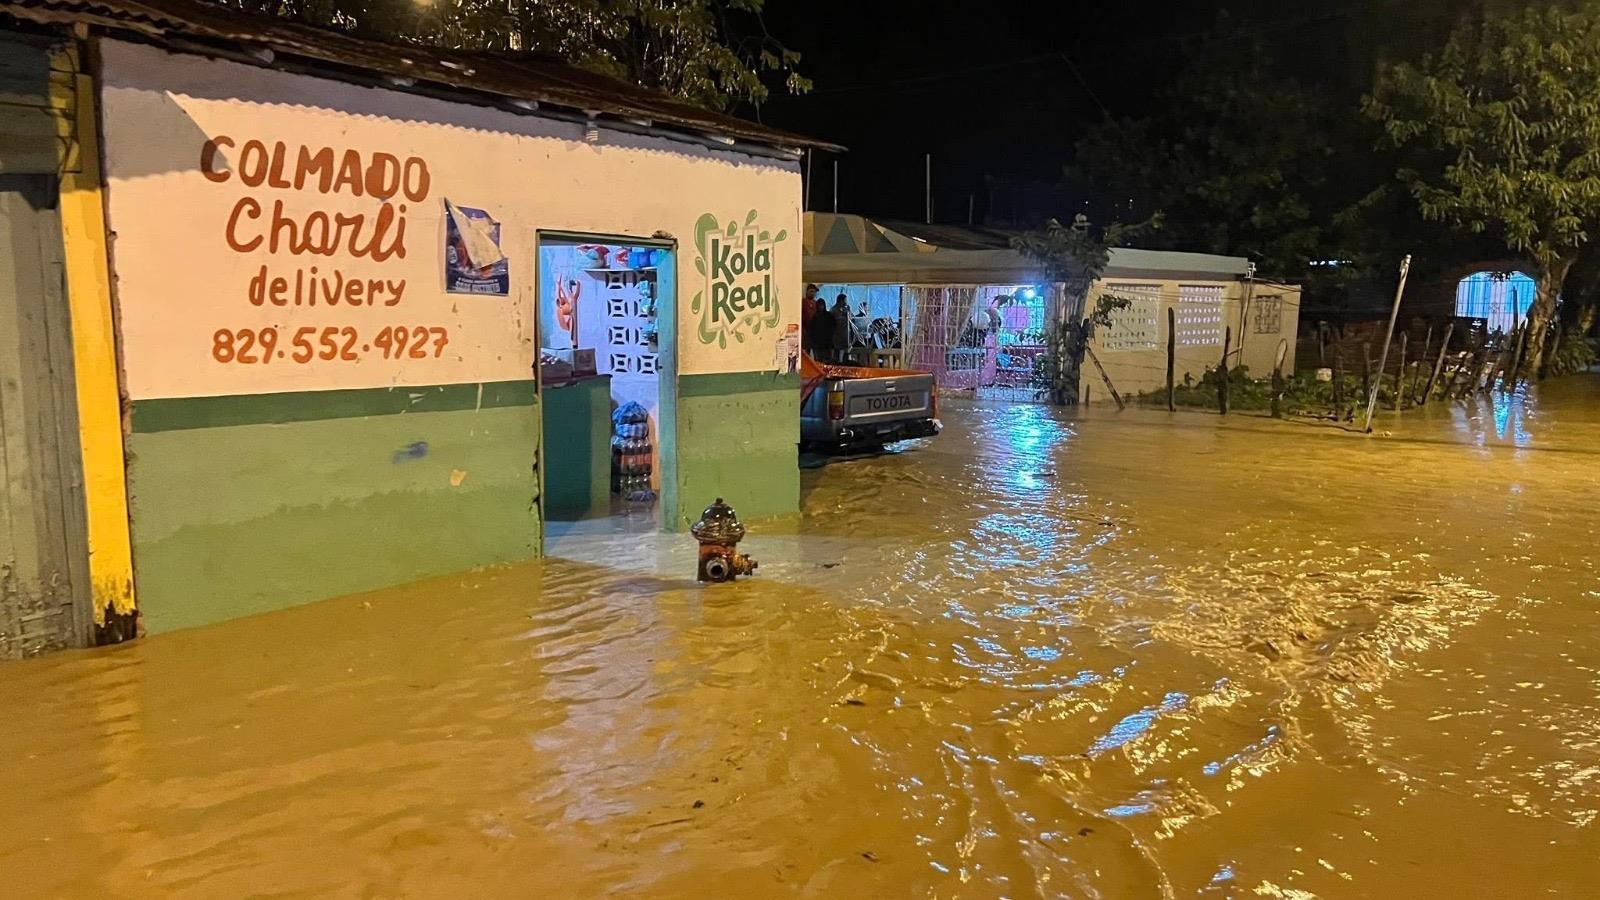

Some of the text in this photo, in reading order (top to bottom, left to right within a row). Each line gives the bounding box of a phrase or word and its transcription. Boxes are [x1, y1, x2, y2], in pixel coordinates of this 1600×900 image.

[201, 136, 430, 202] COLMADO
[226, 196, 406, 262] Charli
[712, 235, 770, 286] Kola
[249, 265, 406, 306] delivery
[712, 275, 770, 323] Real
[867, 395, 911, 410] TOYOTA
